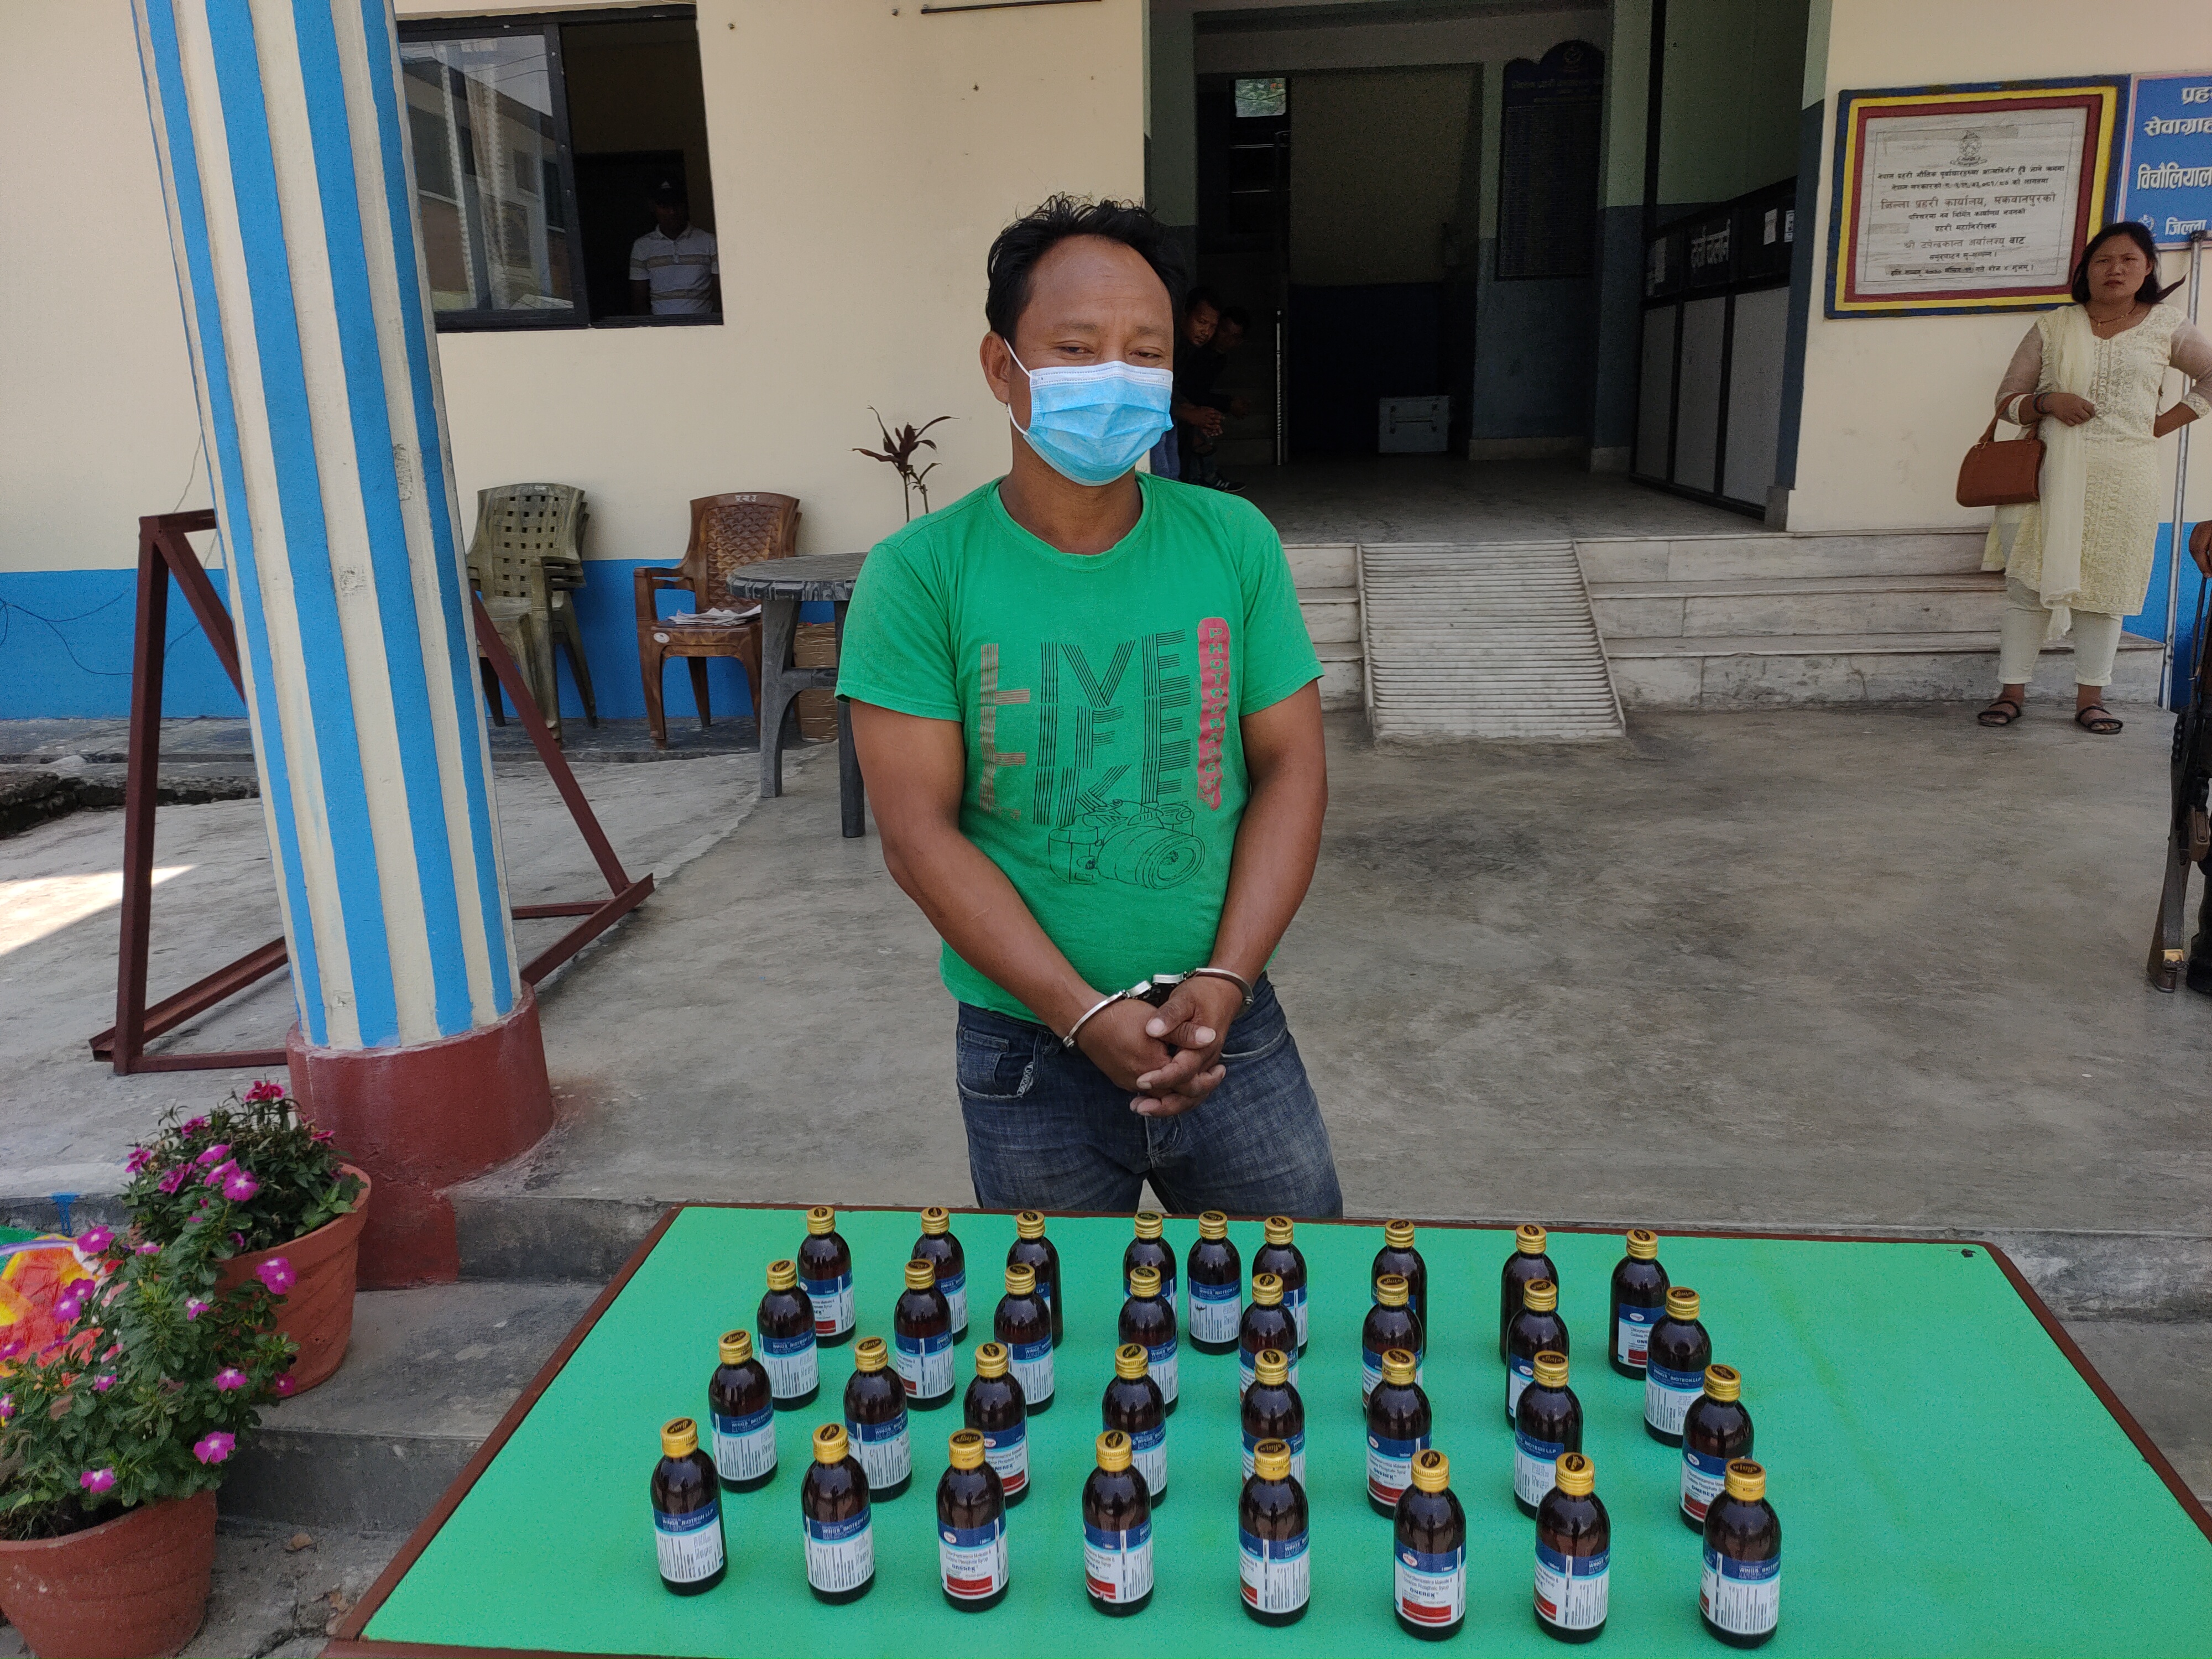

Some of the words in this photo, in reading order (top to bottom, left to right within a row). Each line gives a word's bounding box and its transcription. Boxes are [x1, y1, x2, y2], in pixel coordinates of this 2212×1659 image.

[2181, 87, 2212, 105] प्रह
[1880, 199, 1910, 210] जिल्ला
[1916, 196, 1938, 208] प्रहरी
